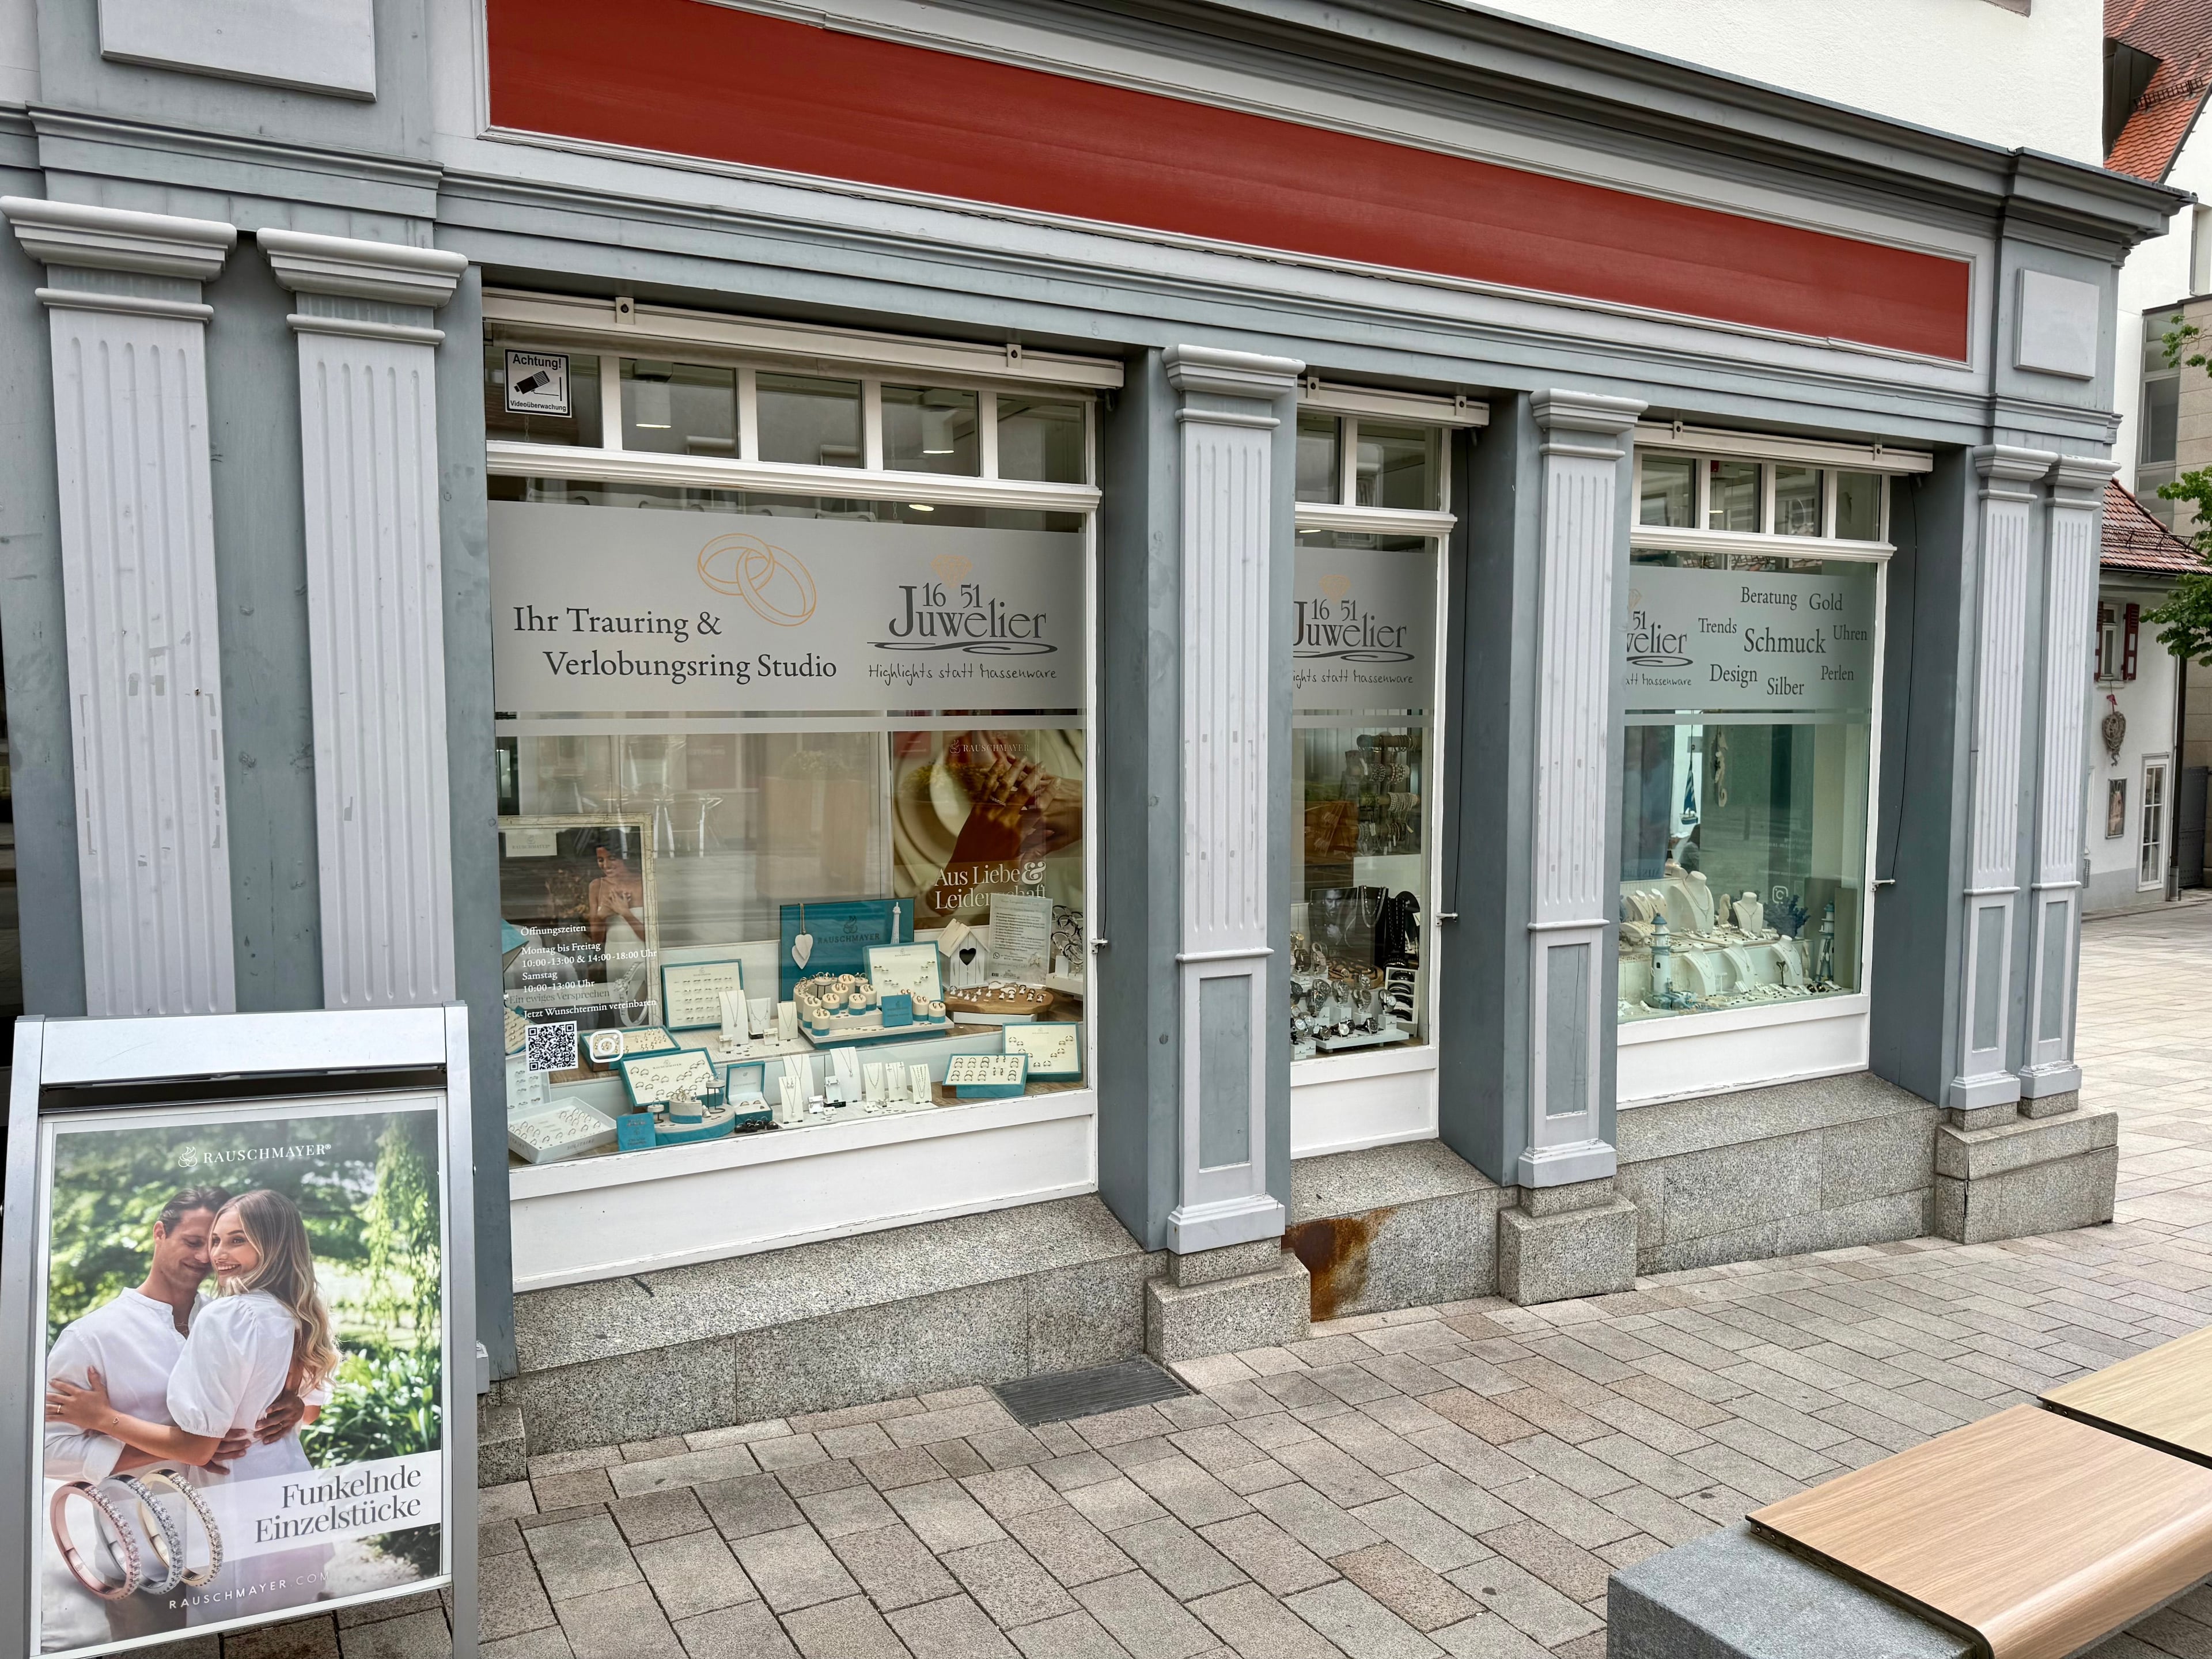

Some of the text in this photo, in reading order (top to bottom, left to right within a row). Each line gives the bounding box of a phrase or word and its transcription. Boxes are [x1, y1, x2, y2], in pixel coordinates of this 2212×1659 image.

[513, 354, 562, 370] Achtung!
[510, 400, 566, 412] Videoüberwachung
[923, 582, 983, 608] 16 51
[1741, 586, 1797, 611] Beratung
[1809, 593, 1843, 611] Gold
[889, 585, 1047, 639] Juwelier
[1311, 599, 1358, 622] 16 51
[1633, 611, 1646, 630] 51
[514, 605, 722, 643] Ihr Trauring &
[1293, 601, 1407, 648] Juwelier
[1698, 617, 1737, 634] Trends
[1833, 624, 1868, 641] Uhren
[1744, 627, 1827, 654] Schmuck
[543, 650, 837, 685] Verlobungsring Studio
[868, 663, 933, 686] Highlights
[938, 662, 974, 679] statt
[1709, 663, 1758, 689] Design
[1820, 665, 1855, 681] Perlen
[1293, 669, 1317, 690] ights
[1321, 669, 1349, 683] statt
[1766, 676, 1805, 696] Silber
[963, 744, 1029, 752] RAUSCHMAYER
[934, 861, 1047, 887] Aus Liebe &
[521, 925, 586, 936] Öffnungszeiten
[817, 933, 880, 944] RAUSCHMAYER
[521, 942, 601, 956] Montag bis Freitag
[577, 955, 586, 963] &
[641, 949, 657, 958] Uhr
[522, 971, 558, 981] Samstag
[577, 979, 595, 988] Uhr
[510, 988, 610, 1005] Ein ewiges Versprechen
[523, 998, 657, 1019] Jetzt Wunschtermin vereinbaren
[281, 1464, 421, 1509] Funkelnde
[255, 1497, 422, 1544] Einzelstücke
[169, 1570, 330, 1610] RAUSCHMAYER.COM
